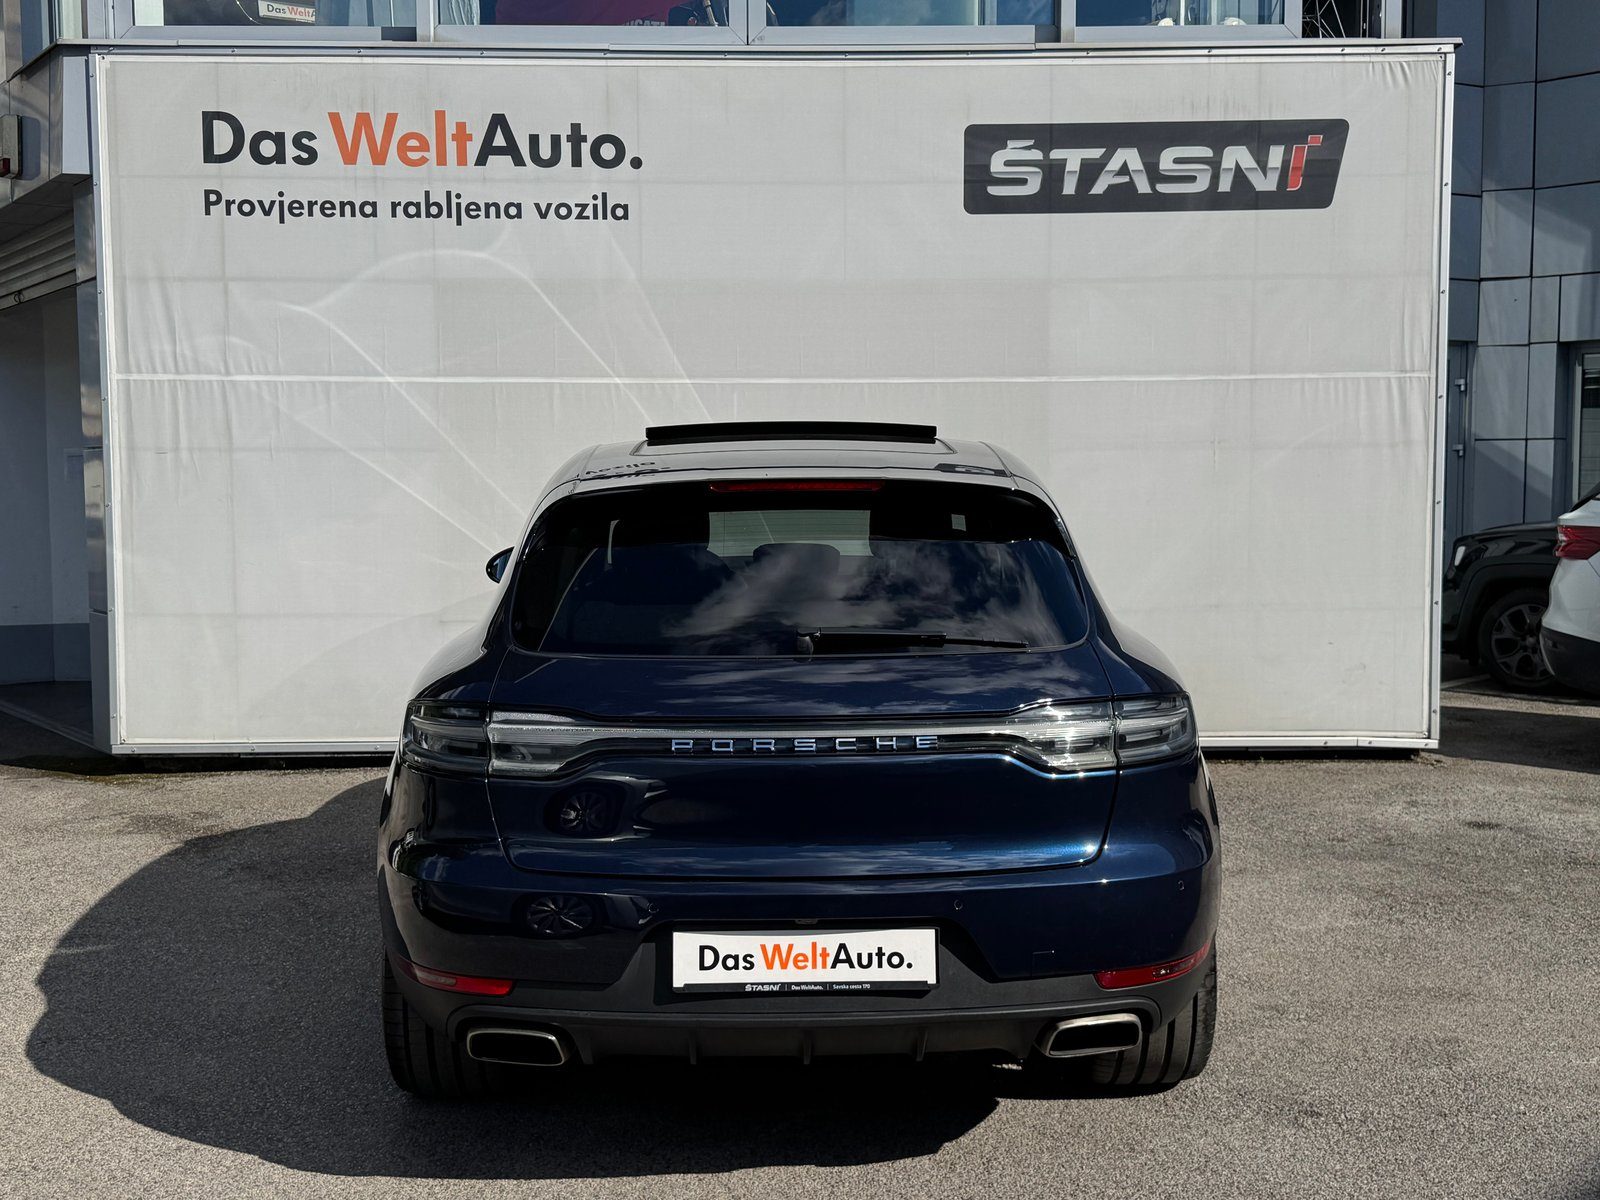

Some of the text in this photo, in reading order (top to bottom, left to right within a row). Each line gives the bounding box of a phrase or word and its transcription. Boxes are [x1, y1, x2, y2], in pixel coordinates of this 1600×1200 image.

[267, 4, 286, 14] Das
[201, 110, 318, 165] Das
[203, 188, 630, 226] Provjerena rabljena vozila
[671, 735, 938, 752] PORSCHE
[699, 944, 755, 971] Das
